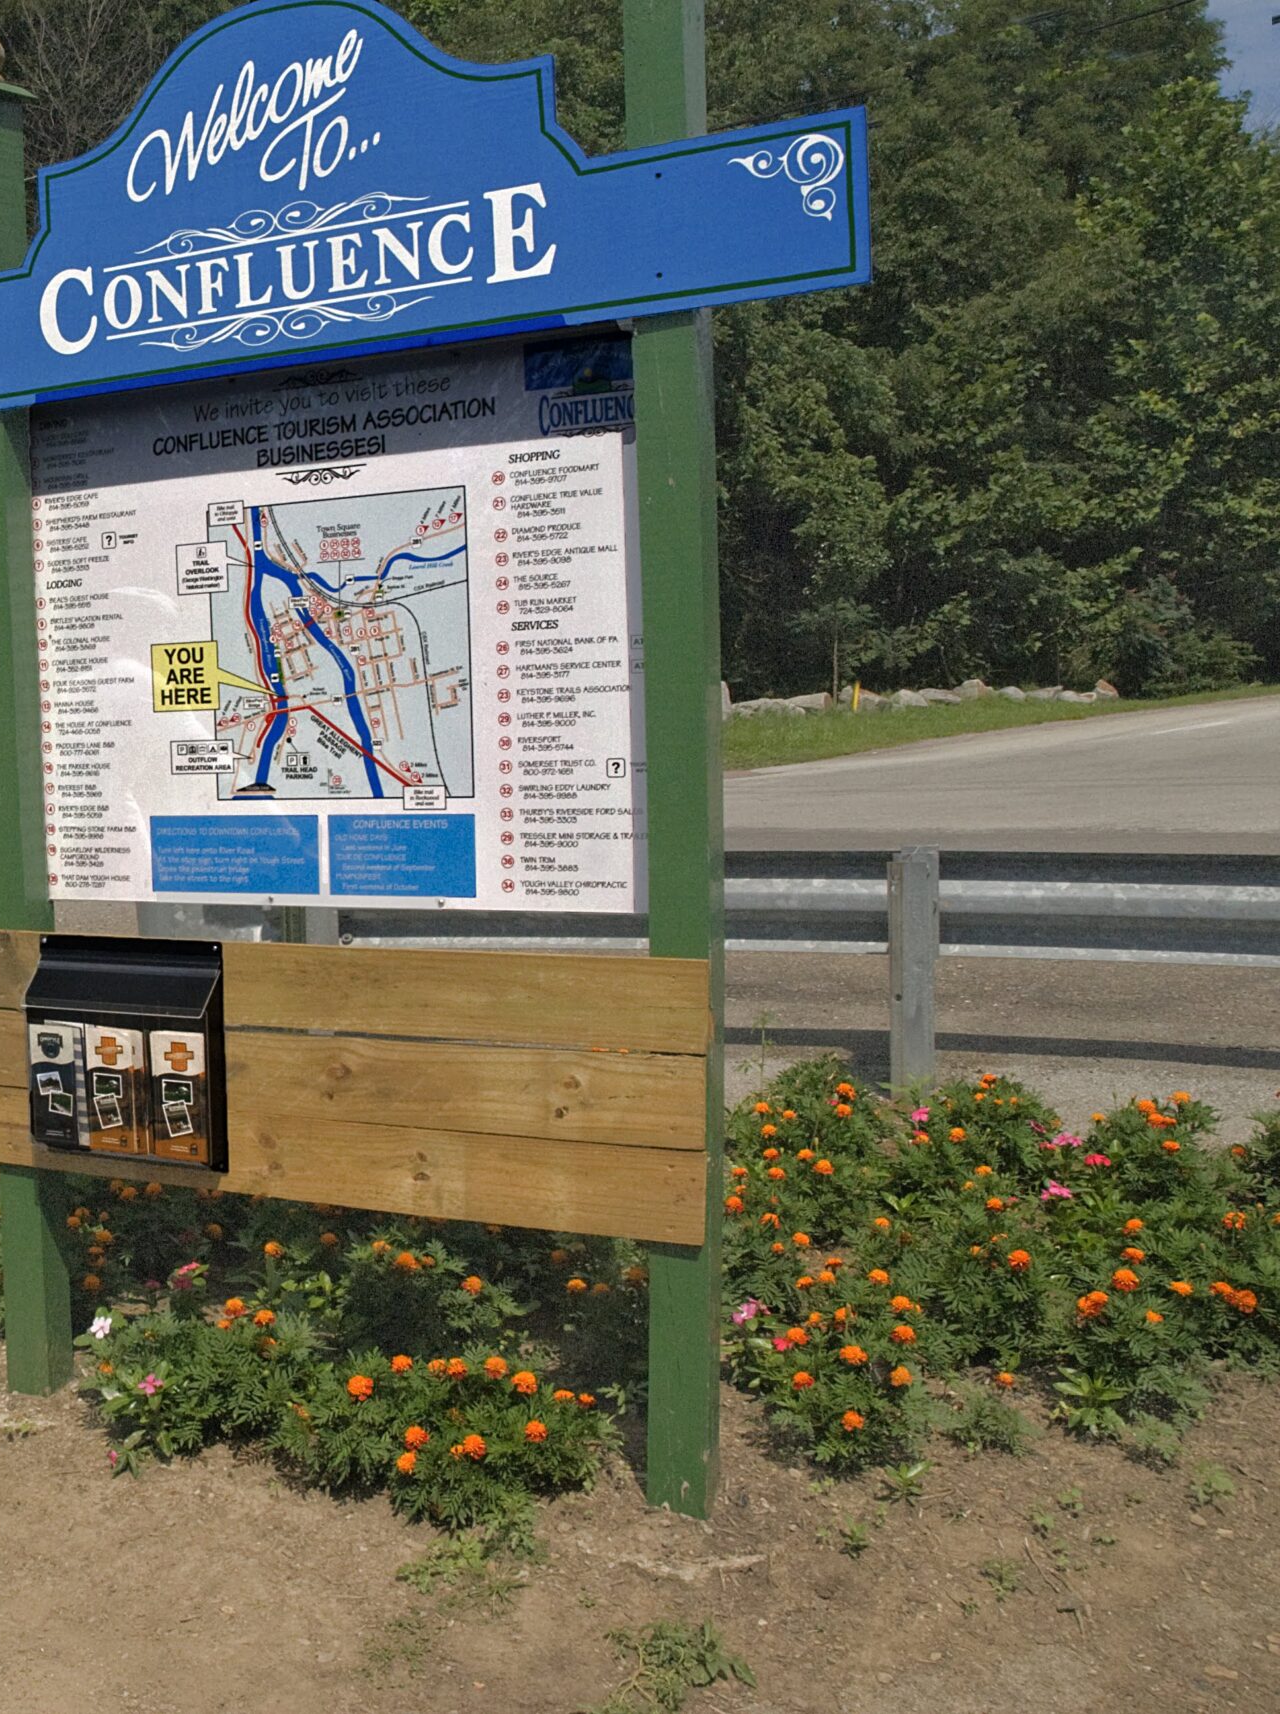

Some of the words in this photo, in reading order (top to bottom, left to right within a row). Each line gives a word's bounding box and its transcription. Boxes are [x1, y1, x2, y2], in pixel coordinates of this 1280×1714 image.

[126, 28, 363, 202] Welcome
[259, 87, 380, 191] To...
[39, 183, 557, 355] CONFLUENCE
[194, 404, 219, 423] We
[225, 399, 274, 419] invite
[279, 396, 312, 416] you
[318, 391, 340, 406] to
[345, 384, 388, 402] visit
[394, 377, 450, 397] these
[539, 393, 634, 436] CONFLUENC
[153, 424, 268, 456] CONFLUENCE
[273, 414, 358, 440] TOURISM
[363, 397, 496, 430] ASSOCIATION
[257, 434, 386, 468] BUSINESSES!
[508, 450, 560, 464] SHOPPING
[510, 468, 556, 479] CONFLUENCE
[559, 463, 600, 473] FOODMART
[45, 496, 65, 504] RIVER'S
[510, 492, 557, 502] CONFLUENCE
[560, 490, 578, 498] TRUE
[580, 488, 603, 496] VALUE
[511, 501, 552, 510] HARDWARE
[46, 517, 80, 525] SHEPHERD'S
[99, 510, 136, 520] RESTAURANT
[317, 525, 335, 533] Town
[337, 523, 361, 531] Square
[512, 526, 546, 535] DIAMOND
[547, 523, 581, 531] PRODUCE
[512, 550, 540, 559] RIVER'S
[565, 546, 596, 554] ANTIQUE
[185, 567, 219, 575] OVERLOOK
[529, 573, 558, 582] SOURCE
[47, 579, 82, 589] LODGING
[547, 596, 577, 605] MARKET
[511, 620, 559, 631] SERVICES
[164, 647, 204, 665] YOU
[516, 663, 559, 671] HARTMAN'S
[166, 668, 204, 685] ARE
[583, 684, 632, 693] ASSOCIATION
[161, 688, 212, 705] HERE
[553, 711, 581, 719] MILLER,
[310, 715, 330, 731] GREAT
[330, 730, 363, 759] ALLEGHENY
[320, 731, 346, 754] PASSAGE
[316, 737, 330, 749] Bike
[329, 746, 342, 759] Trail
[353, 819, 410, 829] CONFLUENCE
[413, 819, 448, 829] EVENTS
